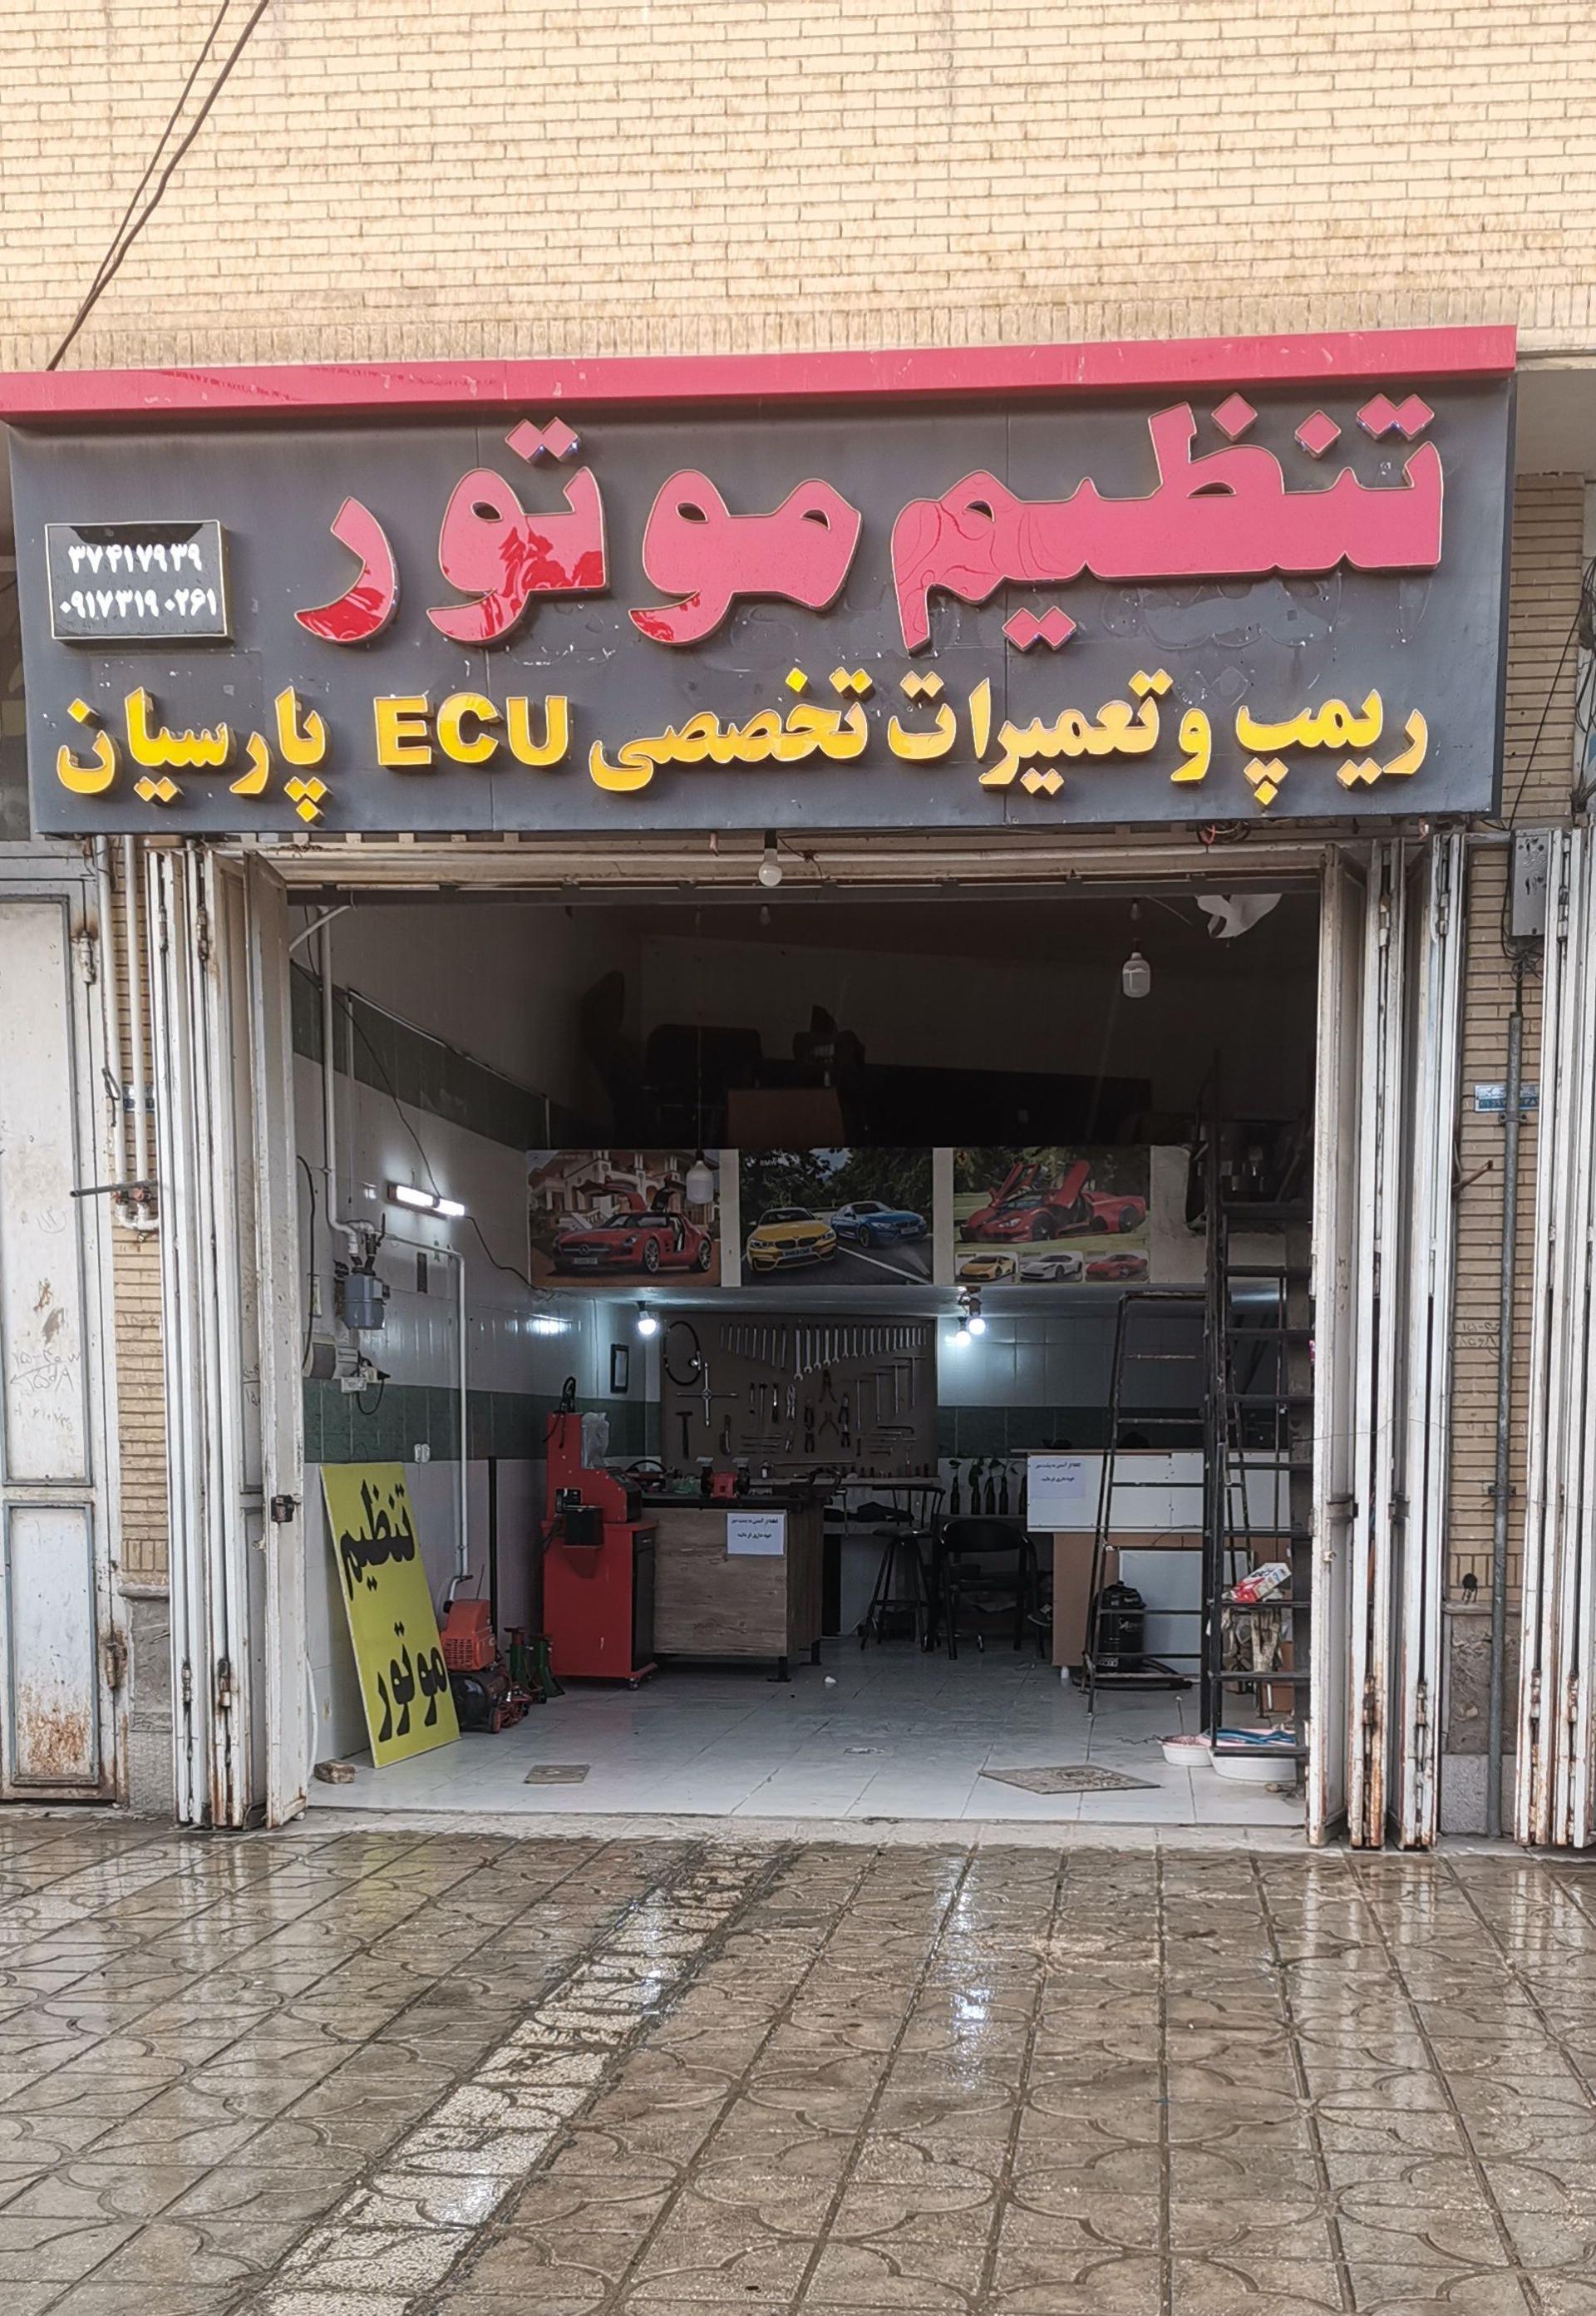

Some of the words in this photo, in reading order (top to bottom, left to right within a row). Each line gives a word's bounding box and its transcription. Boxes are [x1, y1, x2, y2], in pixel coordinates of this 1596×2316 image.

[68, 543, 202, 574] ۳۷۴۱۷۹۳۹
[293, 416, 863, 646] موتور
[891, 392, 1444, 653] تنظیم
[60, 588, 216, 618] ۰۹۱۷۳۱۹۰۲۶۱
[57, 686, 327, 822] پارسیان
[373, 692, 569, 767] ECU
[589, 667, 873, 791] تخصصی
[888, 668, 1173, 795] تعمیرات
[1171, 707, 1212, 783] و
[1236, 689, 1428, 806] ریمپ
[340, 1479, 415, 1602] تنظیم
[377, 1621, 447, 1742] موتور
